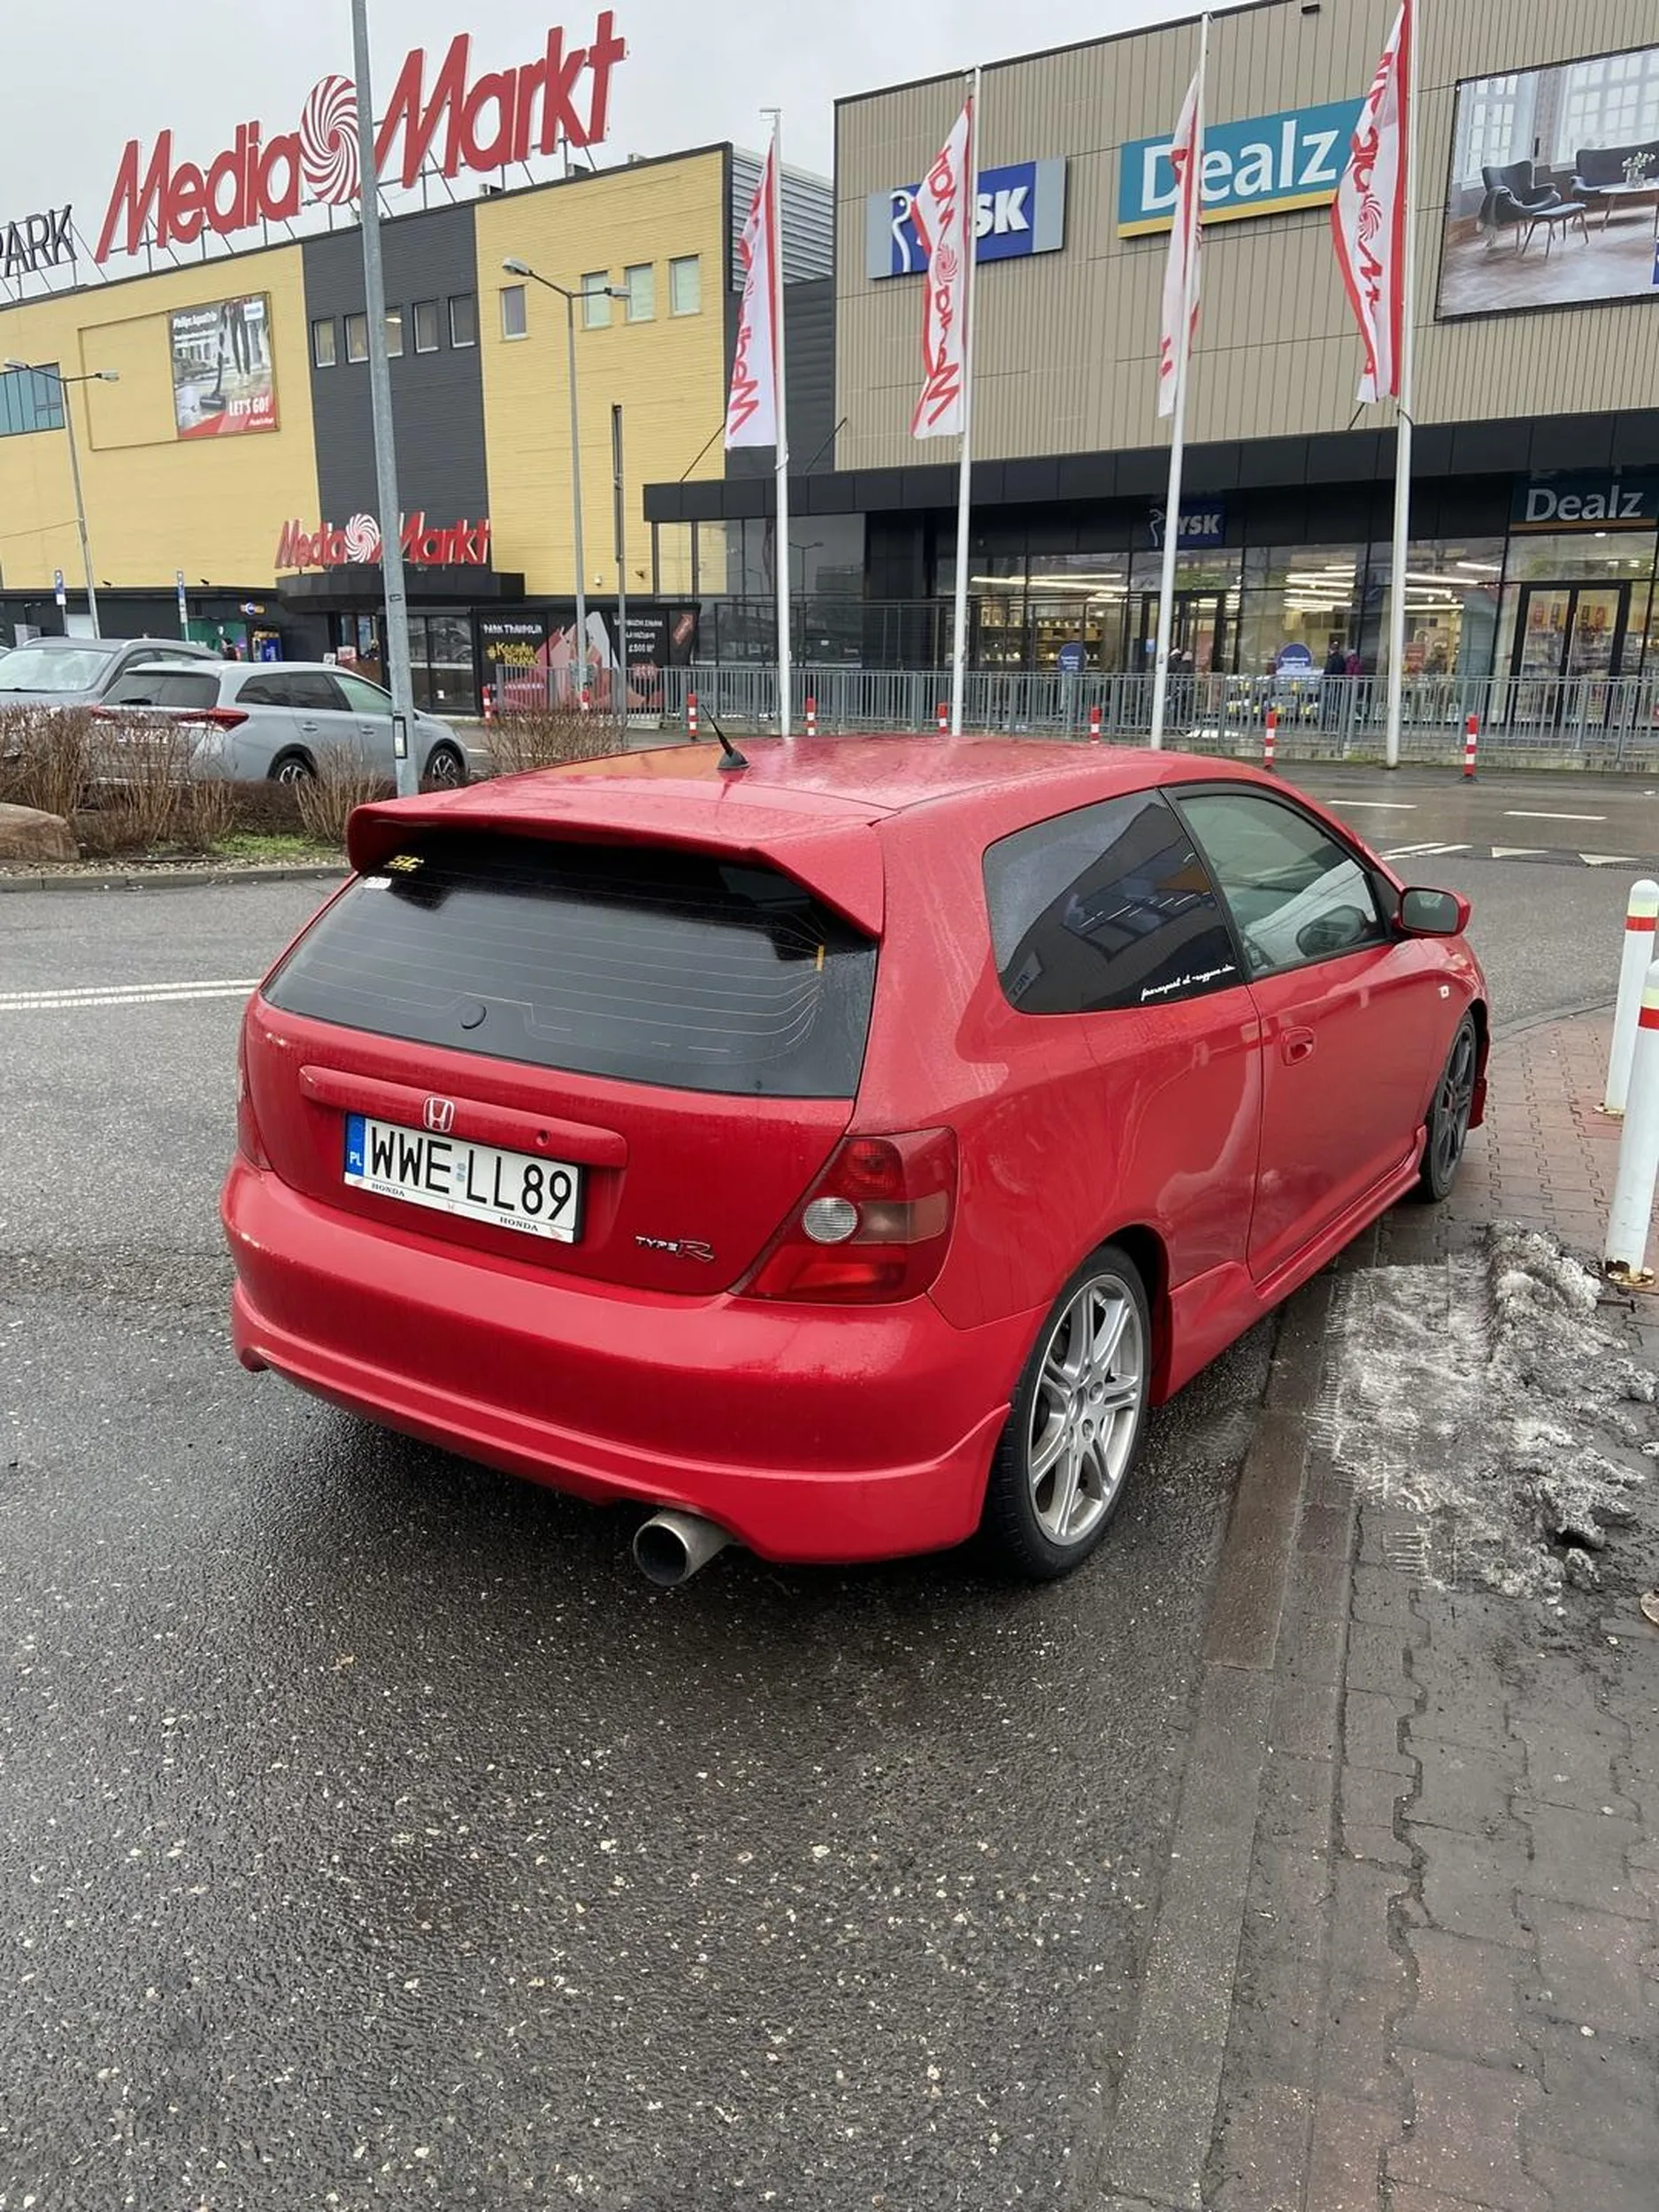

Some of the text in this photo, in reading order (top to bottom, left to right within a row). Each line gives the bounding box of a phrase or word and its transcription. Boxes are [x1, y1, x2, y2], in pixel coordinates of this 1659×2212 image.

[94, 11, 626, 264] Media Markt
[0, 204, 78, 278] ARK
[1525, 485, 1643, 522] Dealz
[274, 510, 492, 569] Media Markt
[1178, 514, 1221, 535] YSK
[349, 1150, 362, 1166] PL
[371, 1126, 572, 1221] WWE LL89
[371, 1182, 406, 1197] HONDA
[499, 1216, 539, 1233] HONDA
[635, 1236, 714, 1263] TYPE R
